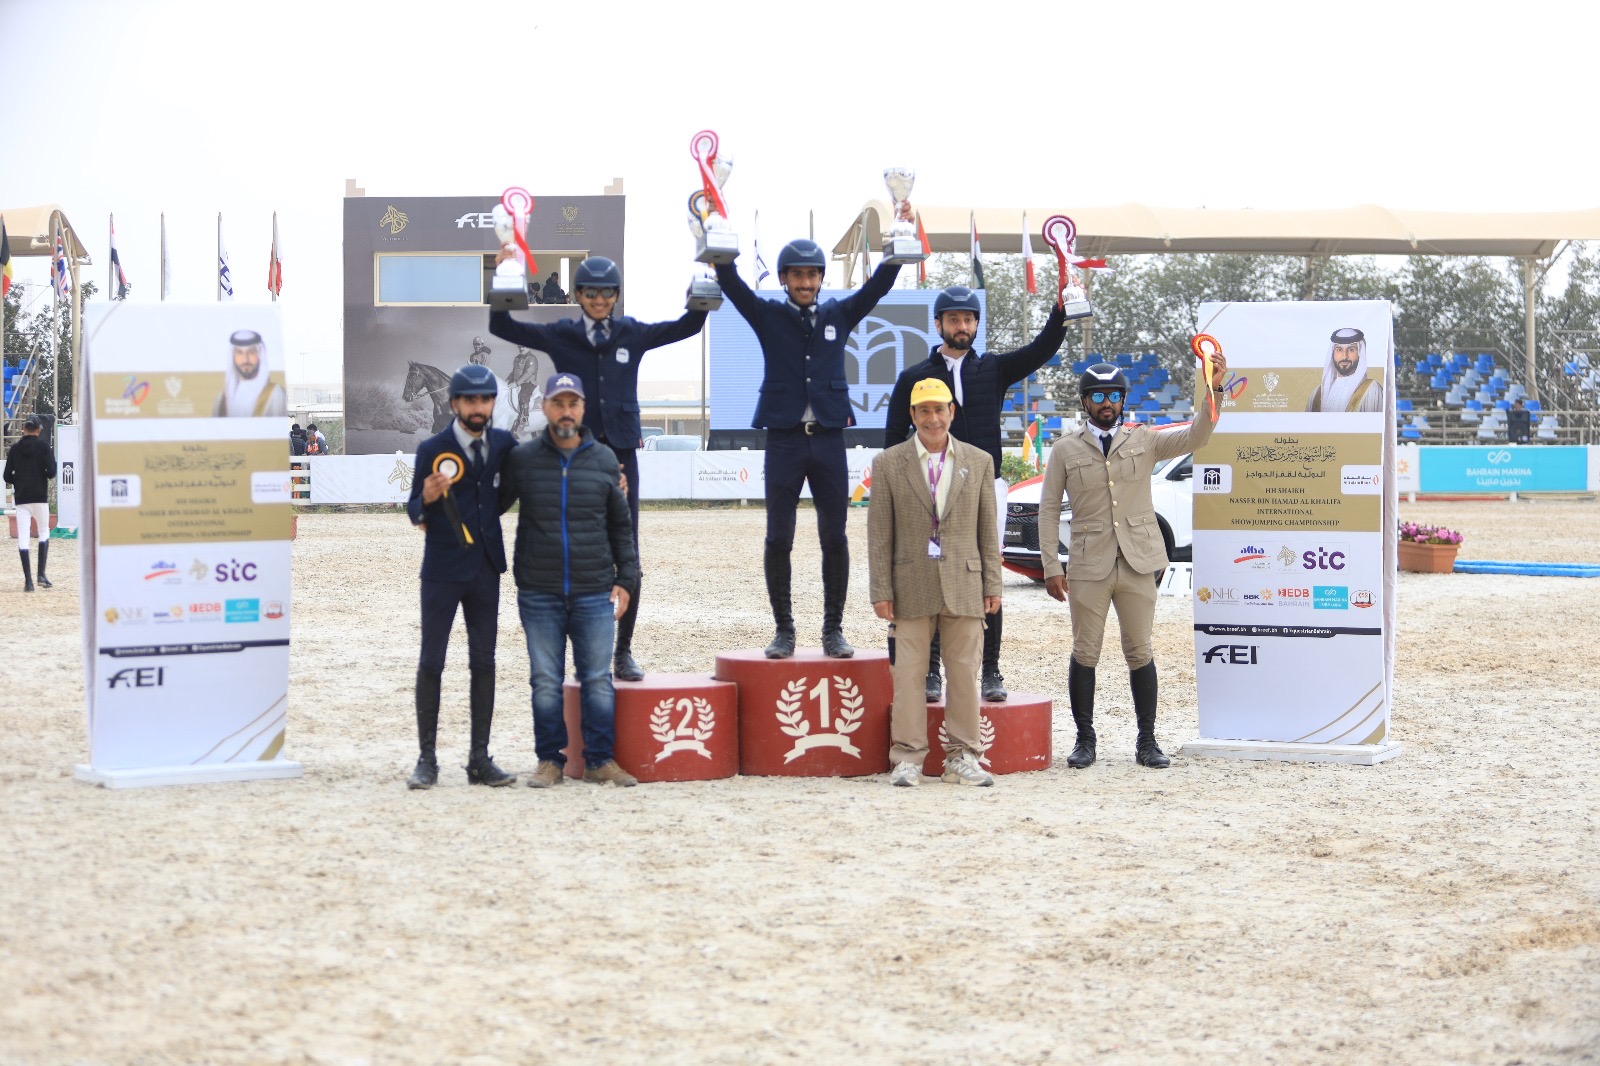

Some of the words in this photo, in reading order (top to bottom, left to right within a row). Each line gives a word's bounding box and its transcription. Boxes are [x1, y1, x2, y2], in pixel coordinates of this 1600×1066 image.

[1274, 437, 1298, 445] بطولة
[1466, 467, 1500, 476] BAHRAIN
[1501, 467, 1532, 476] MARINA
[1231, 518, 1283, 526] SHOWJUMPING
[1302, 546, 1346, 571] stc
[216, 558, 257, 582] stc
[1287, 588, 1310, 598] EDB
[1202, 644, 1258, 665] FEI
[107, 666, 163, 688] FEI
[809, 677, 831, 729] 1
[675, 697, 694, 737] 2
